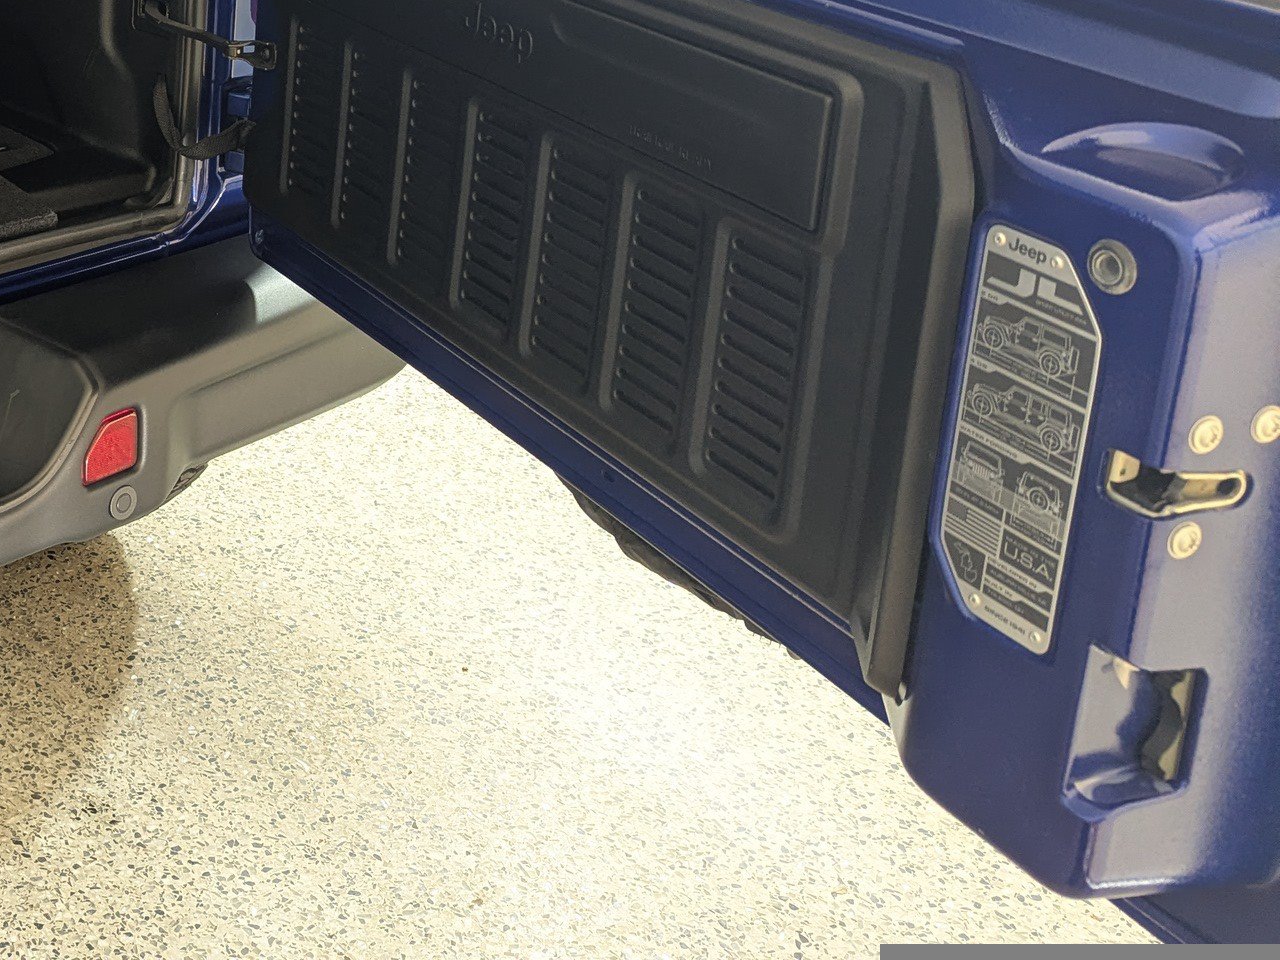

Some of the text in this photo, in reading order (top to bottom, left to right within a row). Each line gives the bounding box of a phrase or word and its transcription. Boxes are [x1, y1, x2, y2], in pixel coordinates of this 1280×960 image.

[464, 1, 534, 64] Jeep
[1008, 237, 1048, 265] Jeep
[986, 267, 1084, 317] JL
[1003, 542, 1053, 582] U.S.A.
